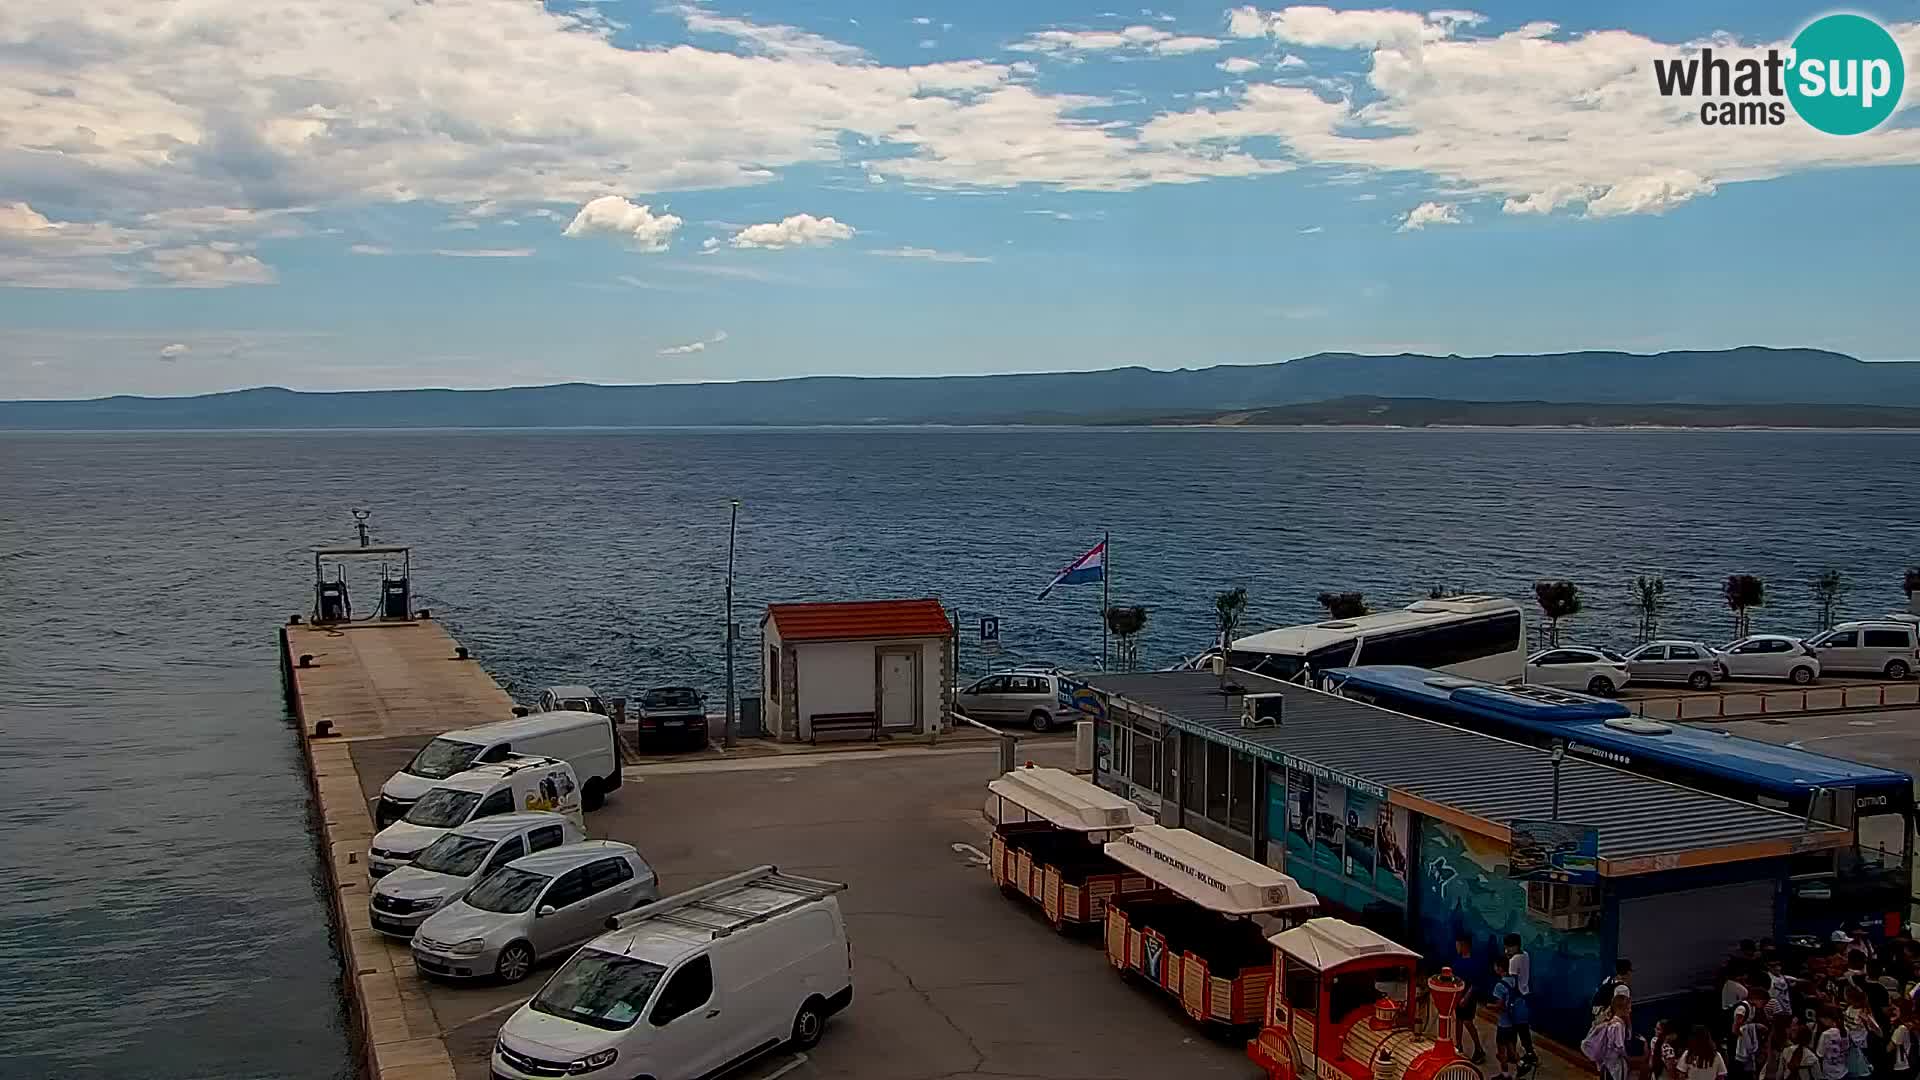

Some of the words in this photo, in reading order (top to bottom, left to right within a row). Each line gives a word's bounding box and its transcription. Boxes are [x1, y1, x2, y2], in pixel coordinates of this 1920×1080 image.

[984, 620, 995, 637] P
[1298, 760, 1329, 780] STATION
[1331, 771, 1356, 788] TICKET
[1357, 780, 1385, 797] OFFICE
[1207, 876, 1227, 893] CENTER
